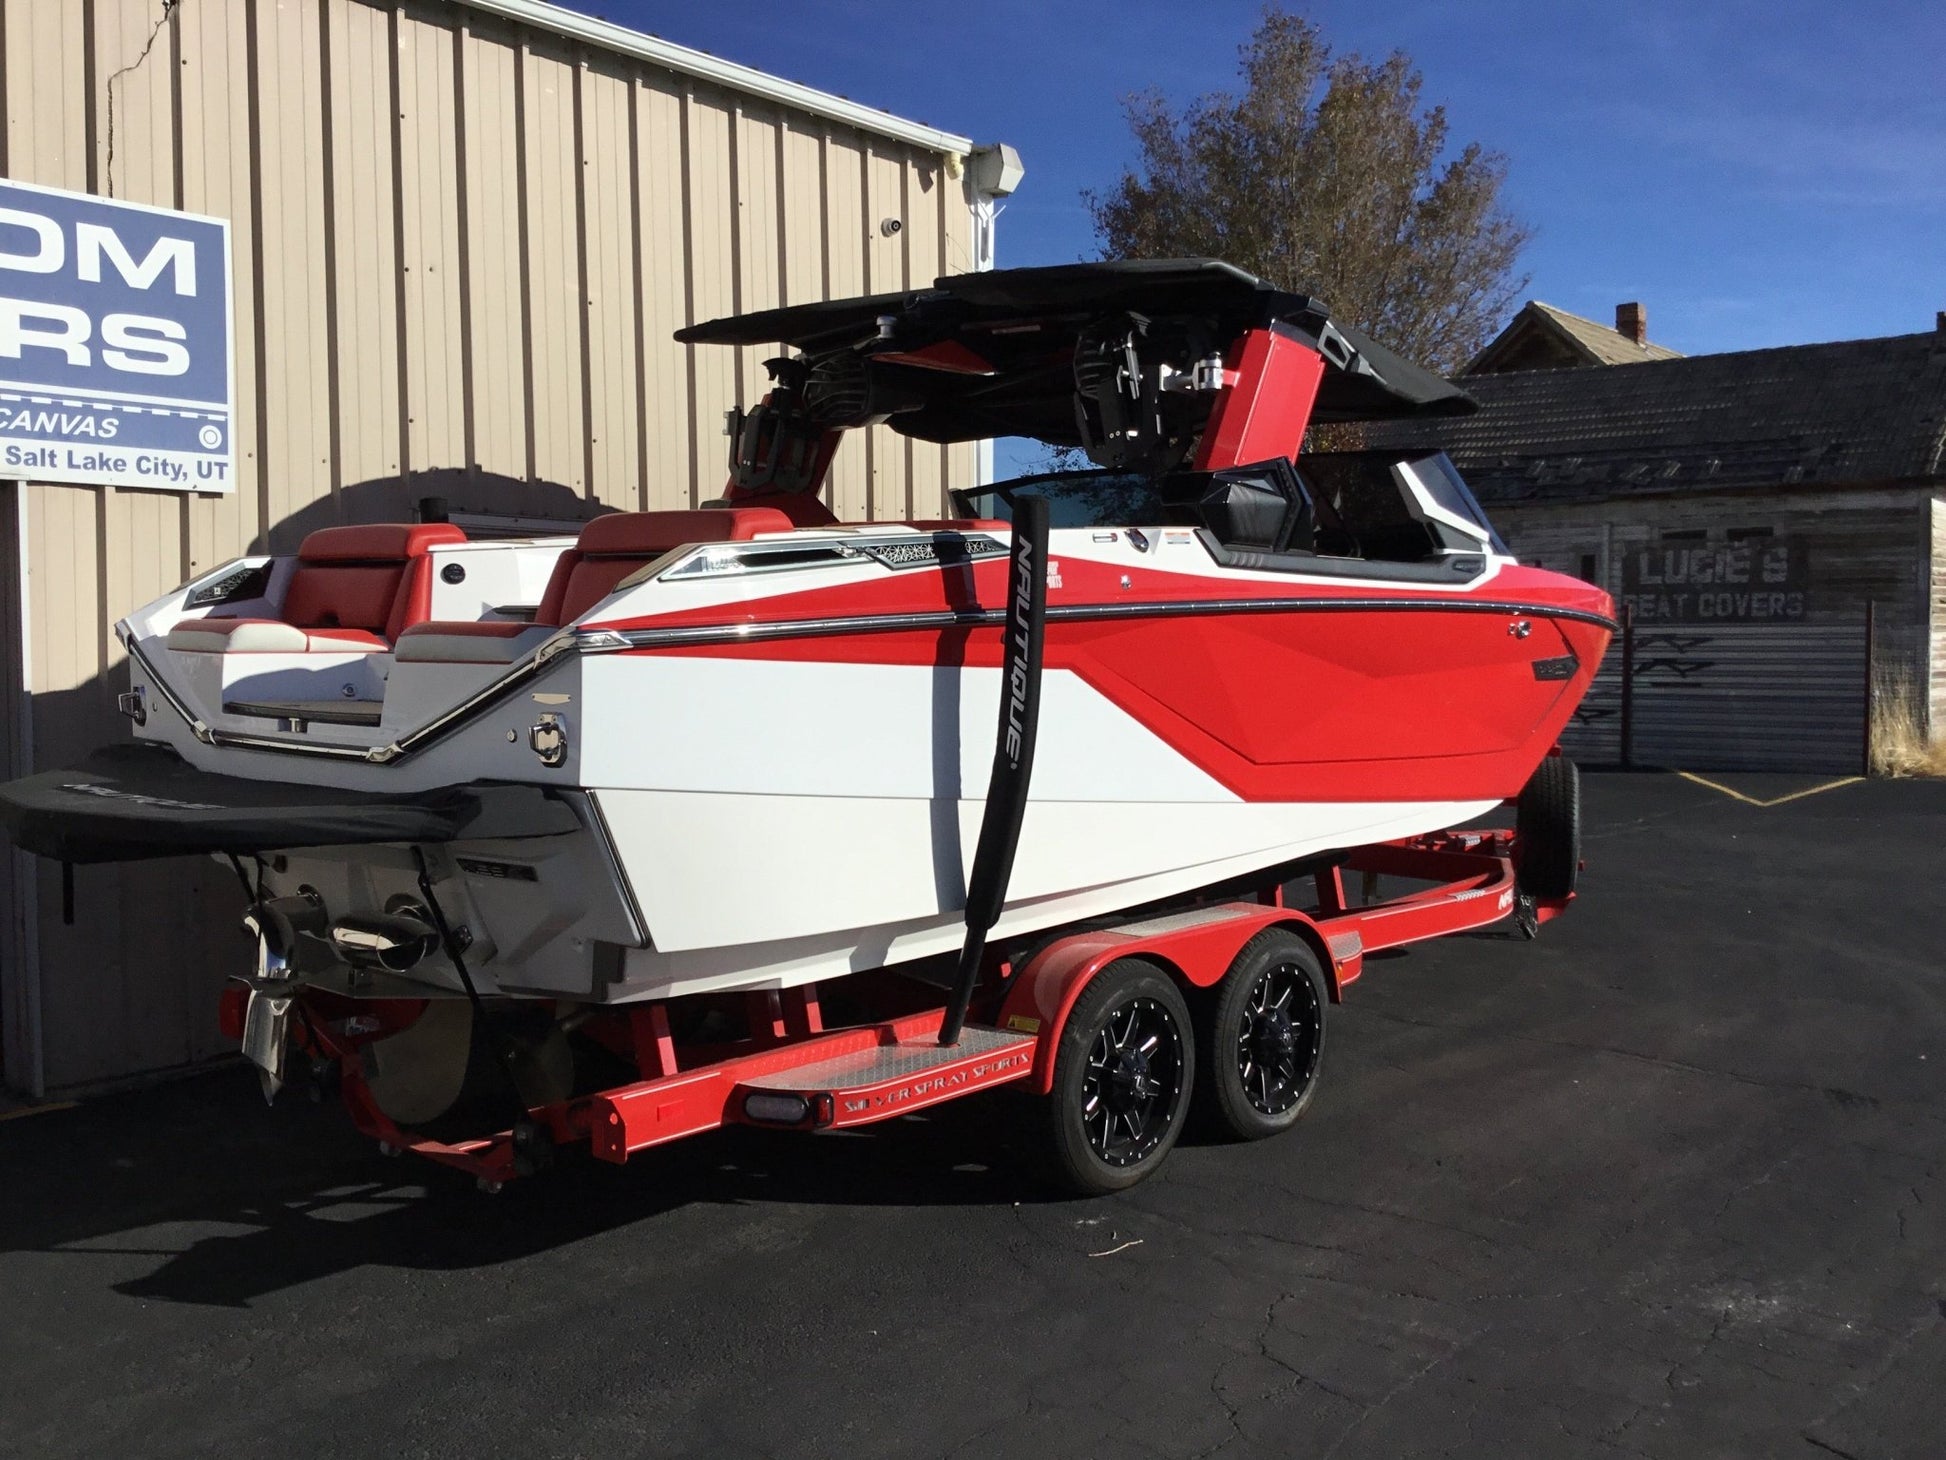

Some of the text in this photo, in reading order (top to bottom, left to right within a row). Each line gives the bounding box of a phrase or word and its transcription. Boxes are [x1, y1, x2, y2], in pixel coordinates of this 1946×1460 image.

[5, 445, 228, 481] Salt Lake City, UT
[1698, 592, 1804, 618] COVERS
[1006, 534, 1032, 763] NAUTIQUE
[845, 1053, 1030, 1112] SILVER SPRAY SPORTS
